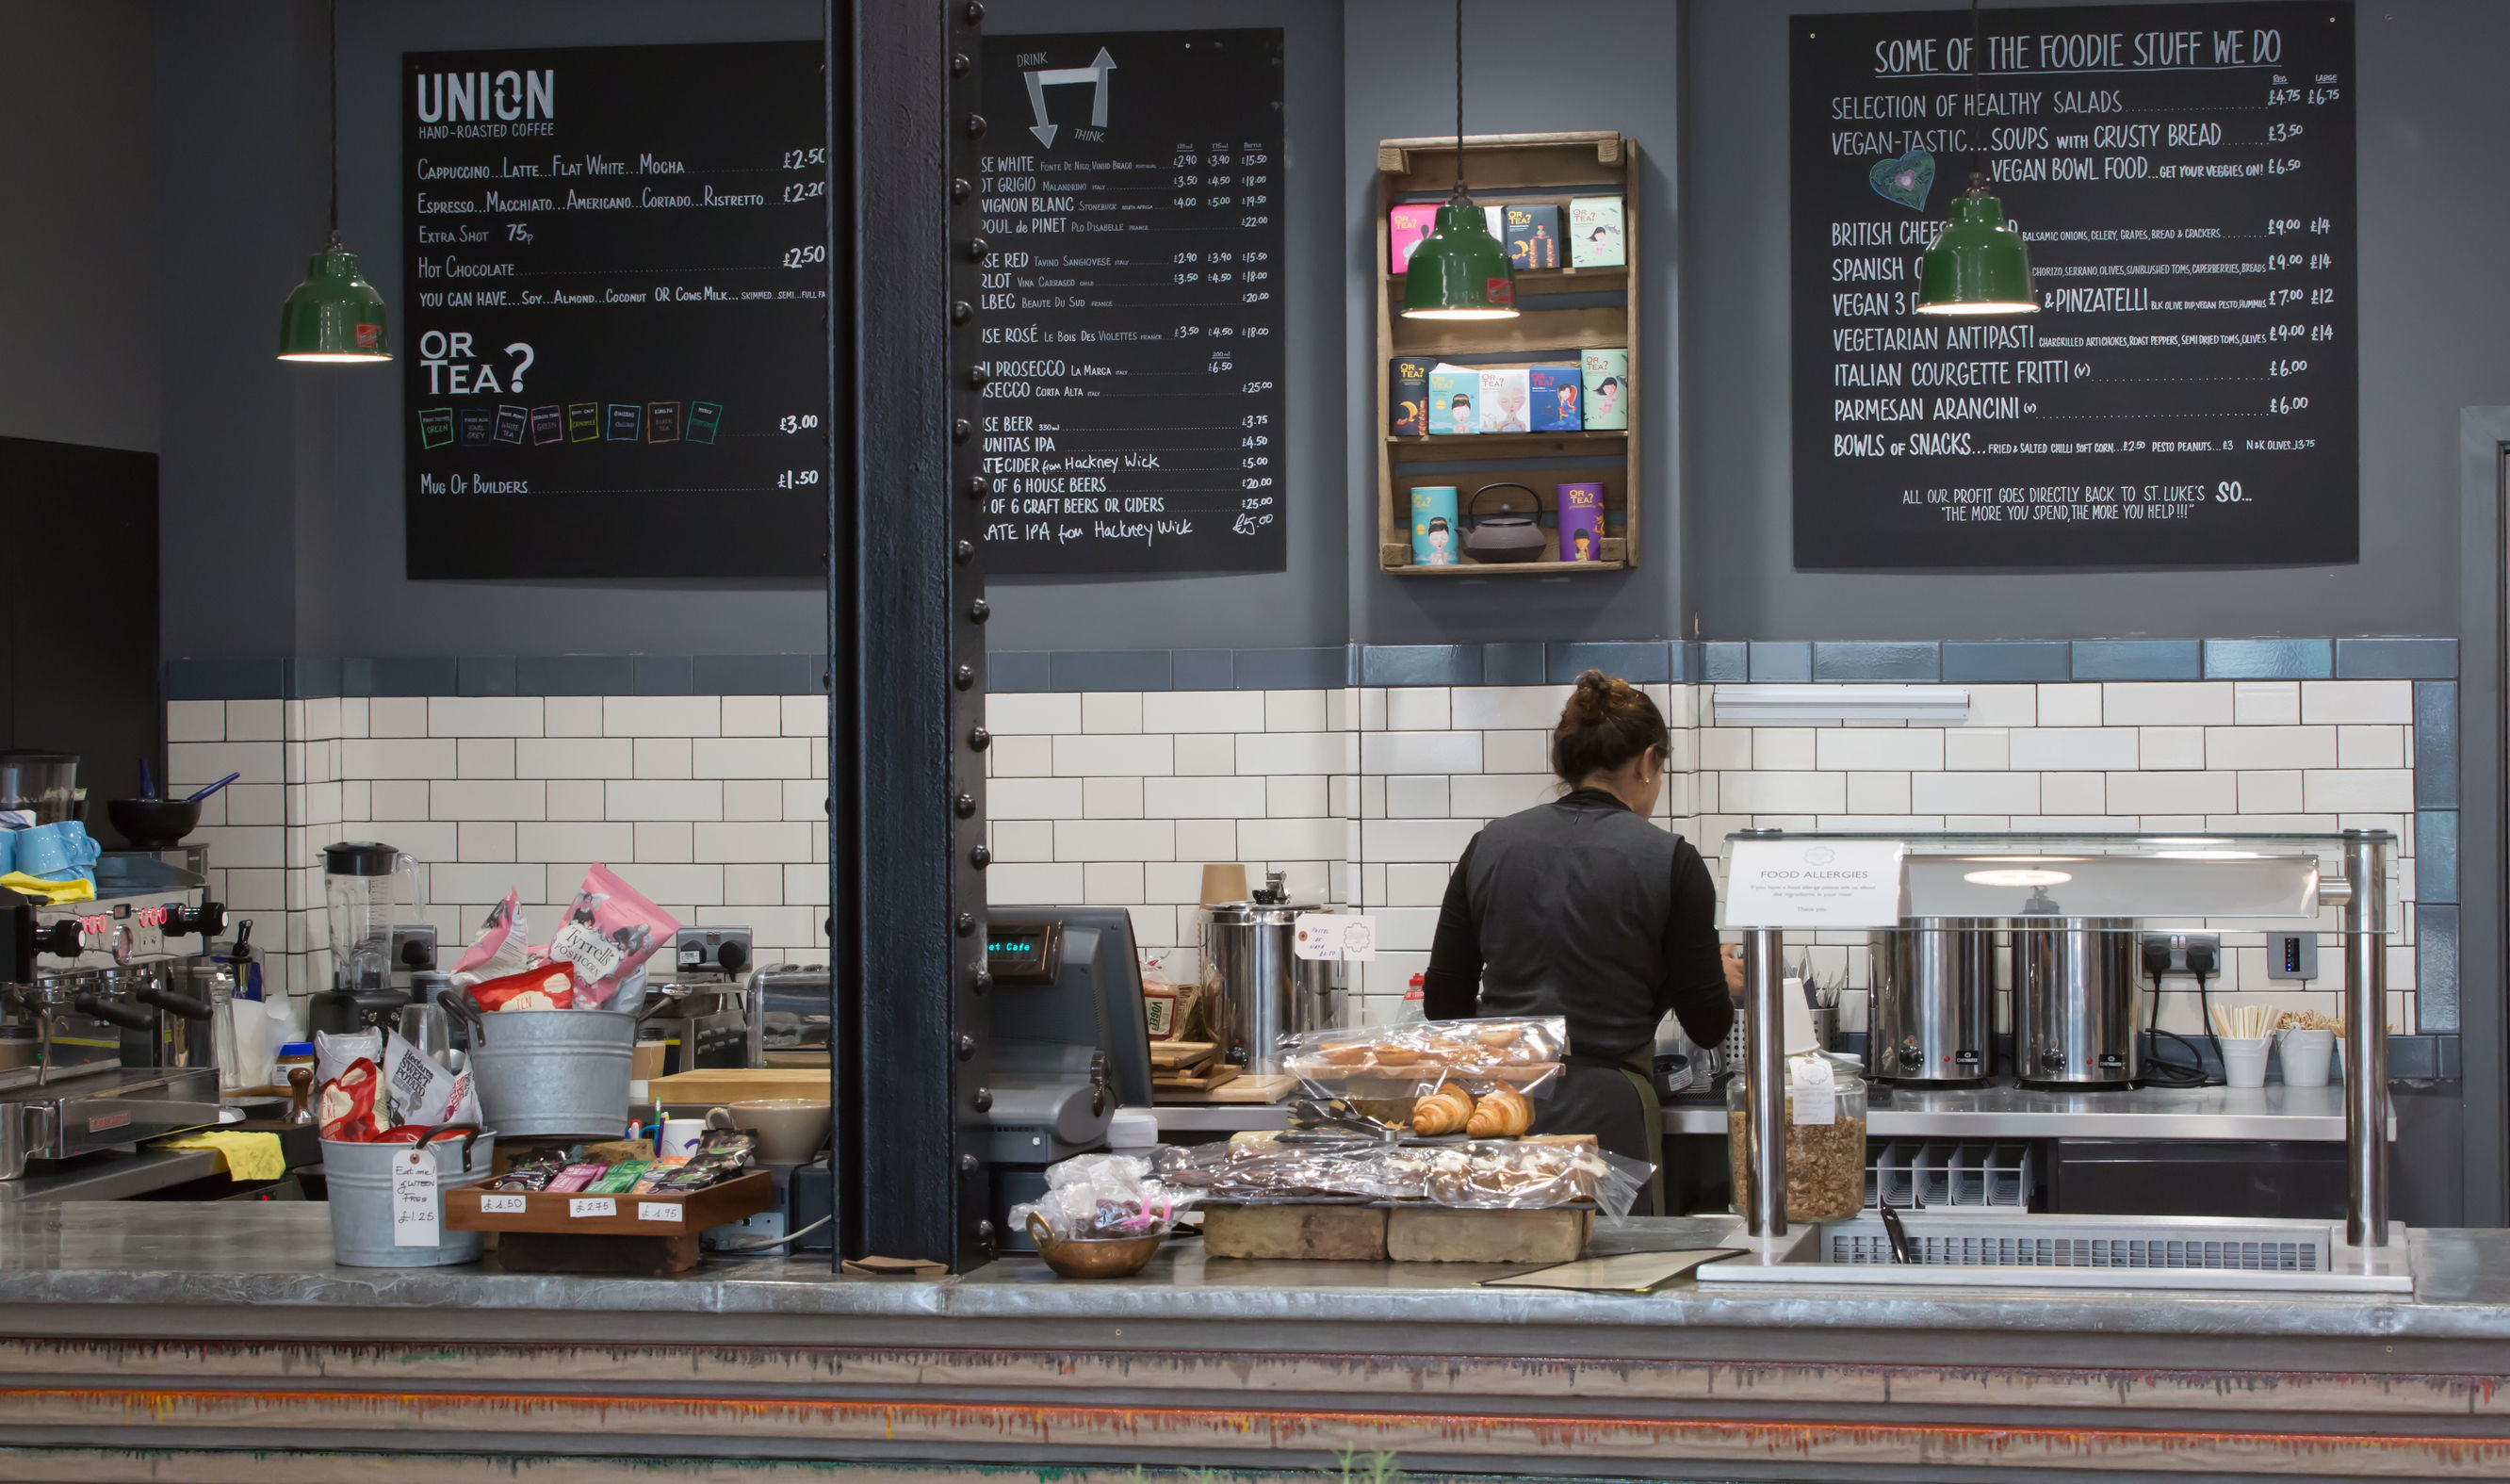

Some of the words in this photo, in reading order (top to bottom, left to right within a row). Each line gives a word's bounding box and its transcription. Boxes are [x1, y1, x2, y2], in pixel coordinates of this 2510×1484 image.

[1018, 52, 1048, 67] DRINK
[1875, 39, 1938, 73] SOME
[1988, 36, 2029, 70] THE
[2041, 34, 2124, 68] FOODIE
[2133, 32, 2203, 66] STUFF
[418, 70, 553, 122] UNION
[1833, 95, 1926, 120] SELECTION
[1965, 92, 2042, 116] HEALTHY
[2054, 90, 2122, 113] SALADS
[2268, 90, 2300, 106] £4.75
[2308, 89, 2339, 105] £6.75
[419, 124, 507, 139] HAND-ROASTED
[513, 122, 554, 136] COFFEE
[1075, 128, 1104, 142] THINK
[1991, 127, 2048, 151] SOUPS
[2057, 136, 2088, 149] WITH
[2094, 124, 2160, 148] CRUSTY
[2169, 122, 2221, 146] BREAD
[2269, 123, 2303, 141] £3.50
[553, 155, 582, 176] FLAT
[641, 154, 685, 173] MOCHA
[998, 156, 1034, 171] WHITE
[1174, 155, 1197, 168] £2.90
[1242, 155, 1266, 166] £15.50
[2052, 158, 2099, 180] BOWL
[2179, 166, 2204, 177] YOUR
[2206, 165, 2243, 177] VEGGIES
[2269, 158, 2301, 174] £6.50
[998, 176, 1035, 192] GRIGIO
[705, 186, 763, 205] RISTRETTO
[1032, 197, 1074, 212] BLANC
[419, 226, 456, 243] EXTRA
[460, 225, 488, 242] SHOT
[507, 223, 533, 244] 75p
[1033, 218, 1067, 233] PINET
[1242, 217, 1267, 227] £22.00
[1833, 222, 1891, 246] BRITISH
[2023, 232, 2058, 241] BALSAMIC
[2152, 230, 2175, 238] BREAD
[2185, 229, 2221, 238] CRACKERS
[2268, 220, 2300, 236] £9.00
[2310, 218, 2330, 235] £14
[419, 257, 442, 278] HOT
[447, 255, 513, 277] CHOCOLATE
[783, 246, 824, 269] £2.50
[1005, 253, 1028, 268] RED
[1833, 257, 1903, 281] SPANISH
[420, 293, 442, 306] YOU
[448, 292, 472, 306] CAN
[606, 288, 646, 302] COCONUT
[655, 287, 670, 302] OR
[1022, 298, 1051, 308] BEAUTE
[1069, 297, 1084, 307] SUD
[1833, 293, 1888, 316] VEGAN
[2311, 288, 2334, 304] £12
[1005, 324, 1038, 343] ROSÉ
[1834, 327, 1937, 351] VEGETARIAN
[1947, 325, 2033, 350] ANTIPASTI
[420, 331, 476, 359] OR
[420, 340, 534, 394] TEA?
[997, 360, 1065, 377] PROSECCO
[1084, 365, 1111, 375] MARCA
[1209, 362, 1232, 373] £6.50
[1835, 363, 1901, 386] ITALIAN
[1912, 362, 2011, 386] COURGETTE
[2018, 360, 2067, 383] FRITTI
[2270, 360, 2307, 377] £6.00
[1036, 386, 1060, 397] CORTA
[1064, 386, 1084, 396] ALTA
[1835, 399, 1923, 421] PARMESAN
[1933, 397, 2018, 420] ARANCINI
[780, 416, 818, 433] £3.00
[1004, 416, 1033, 432] BEER
[1242, 416, 1267, 428] £3.75
[1035, 437, 1055, 451] IPA
[1834, 434, 1884, 457] BOWLS
[1989, 444, 2012, 453] FRIED
[2020, 443, 2047, 453] SALTED
[1066, 455, 1118, 473] Hackney
[1125, 452, 1160, 468] Wick
[421, 473, 446, 494] MUG
[451, 474, 467, 494] OF
[474, 474, 528, 494] BUILDERS
[777, 470, 818, 489] £1.50
[1026, 478, 1065, 493] HOUSE
[1070, 477, 1106, 492] BEERS
[1954, 488, 1993, 503] PROFIT
[1999, 488, 2024, 503] GOES
[2029, 486, 2079, 502] DIRECTLY
[2086, 486, 2114, 502] BACK
[1024, 498, 1060, 514] CRAFT
[1125, 497, 1165, 513] CIDERS
[1972, 506, 2001, 520] MORE
[2007, 505, 2029, 520] YOU
[1026, 522, 1050, 540] IPA
[1095, 520, 1152, 546] Hackney
[1158, 519, 1193, 534] Wick
[1803, 871, 1868, 879] ALLERGIES
[1006, 942, 1030, 952] Cafe
[399, 1057, 431, 1088] SWEET
[396, 1068, 426, 1097] POTATO
[399, 1211, 435, 1224] £1.25
